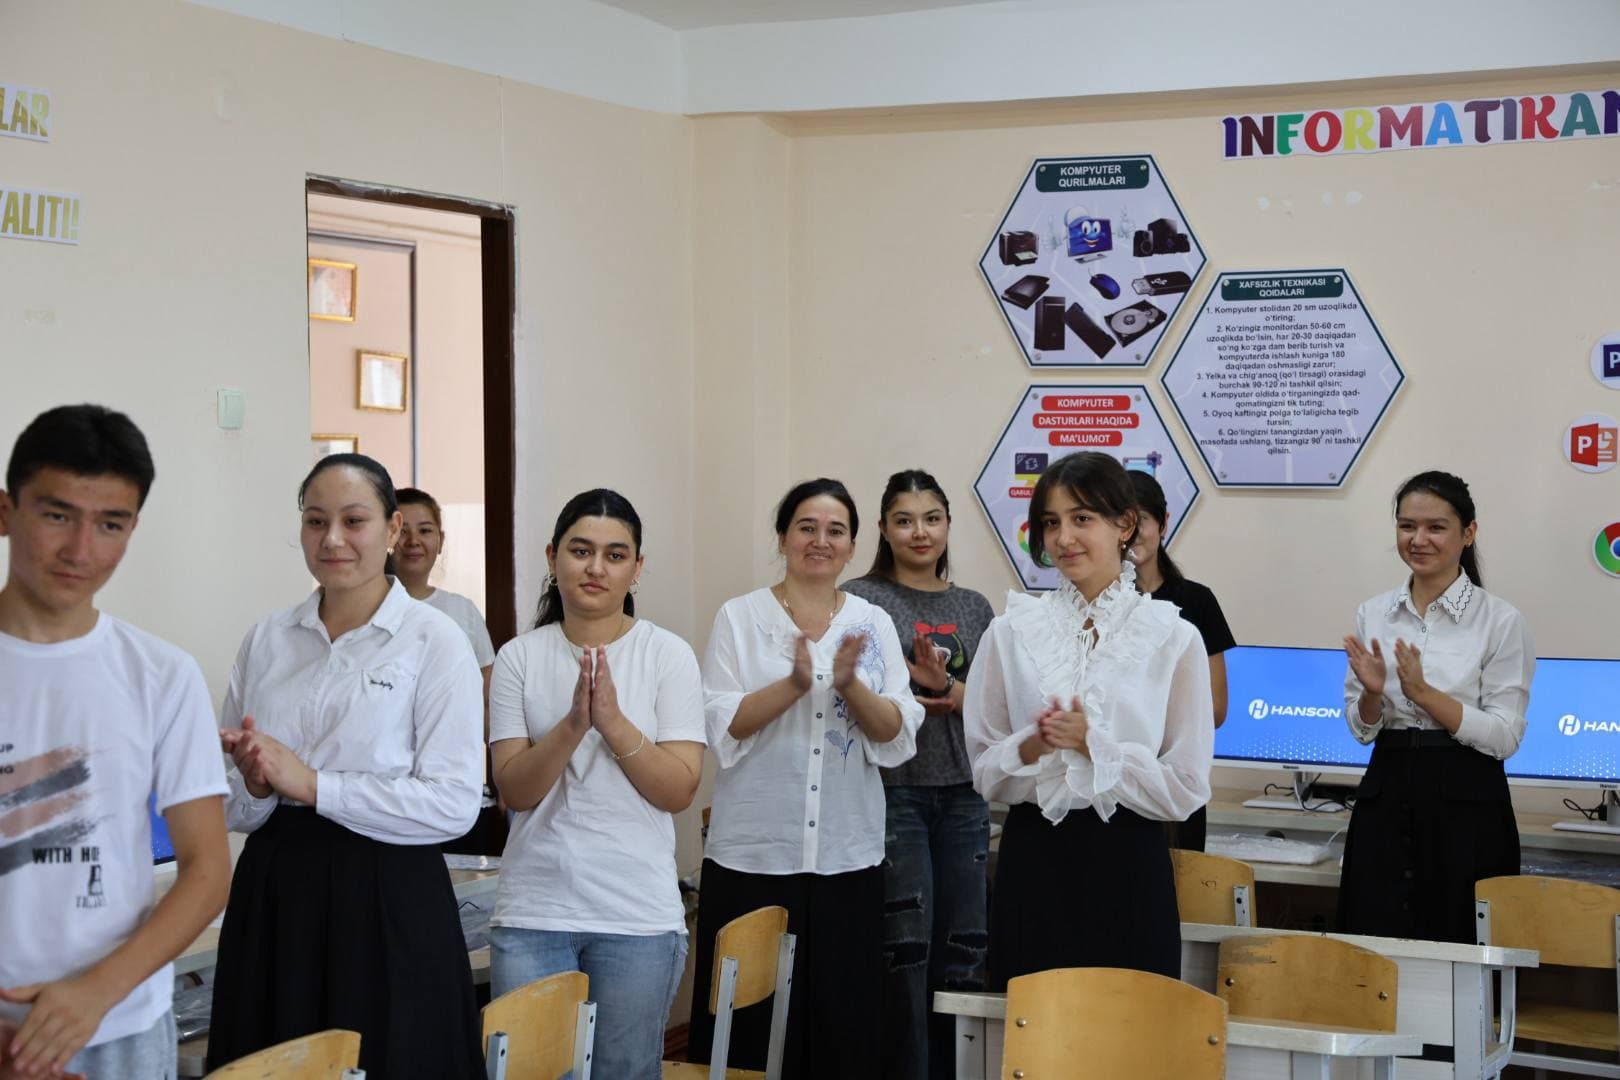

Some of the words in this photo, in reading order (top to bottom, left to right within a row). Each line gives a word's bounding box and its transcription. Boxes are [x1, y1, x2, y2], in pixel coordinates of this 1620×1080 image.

[1060, 165, 1122, 176] KOMPYUTER
[1058, 176, 1126, 188] QURILMALARI
[0, 189, 80, 240] ALITI!
[1239, 279, 1281, 289] XAFSIZLIK
[1282, 278, 1326, 287] TEXNIKASI
[1259, 288, 1305, 297] QOIDALARI
[1215, 306, 1257, 315] Kompyuter
[1259, 304, 1291, 312] stolidan
[1318, 303, 1357, 312] uzoqlikda
[1262, 323, 1308, 331] monitordan
[1310, 322, 1331, 330] 50-60
[1206, 335, 1244, 343] uzoqlikda
[1276, 333, 1289, 341] har
[1291, 332, 1312, 340] 20-30
[1314, 331, 1356, 341] daqiqadan
[1287, 342, 1308, 350] berib
[1309, 341, 1333, 349] turish
[1219, 353, 1270, 362] kompyuterda
[1302, 351, 1329, 360] kuniga
[1225, 362, 1266, 371] daqiqadan
[1267, 362, 1311, 370] oshmasligi
[1205, 372, 1226, 380] Yelka
[1328, 368, 1366, 379] orasidagi
[1210, 391, 1253, 400] Kompyuter
[1057, 399, 1114, 408] KOMPYUTER
[1235, 400, 1286, 408] qomatingizni
[1211, 409, 1233, 419] Oyoq
[1234, 409, 1267, 418] kaftingiz
[1269, 409, 1291, 418] polga
[1338, 408, 1359, 417] tegib
[1038, 416, 1095, 425] DASTURLARI
[1096, 416, 1133, 427] HAQIDA
[1270, 427, 1318, 437] tanangizdan
[1320, 427, 1343, 438] yaqin
[1200, 438, 1238, 446] masofada
[1274, 437, 1309, 446] tizzangiz
[1334, 436, 1361, 444] tashkil
[1578, 435, 1592, 454] P
[1270, 705, 1341, 718] HANSON
[1583, 720, 1620, 732] HAN
[32, 847, 72, 864] WITH
